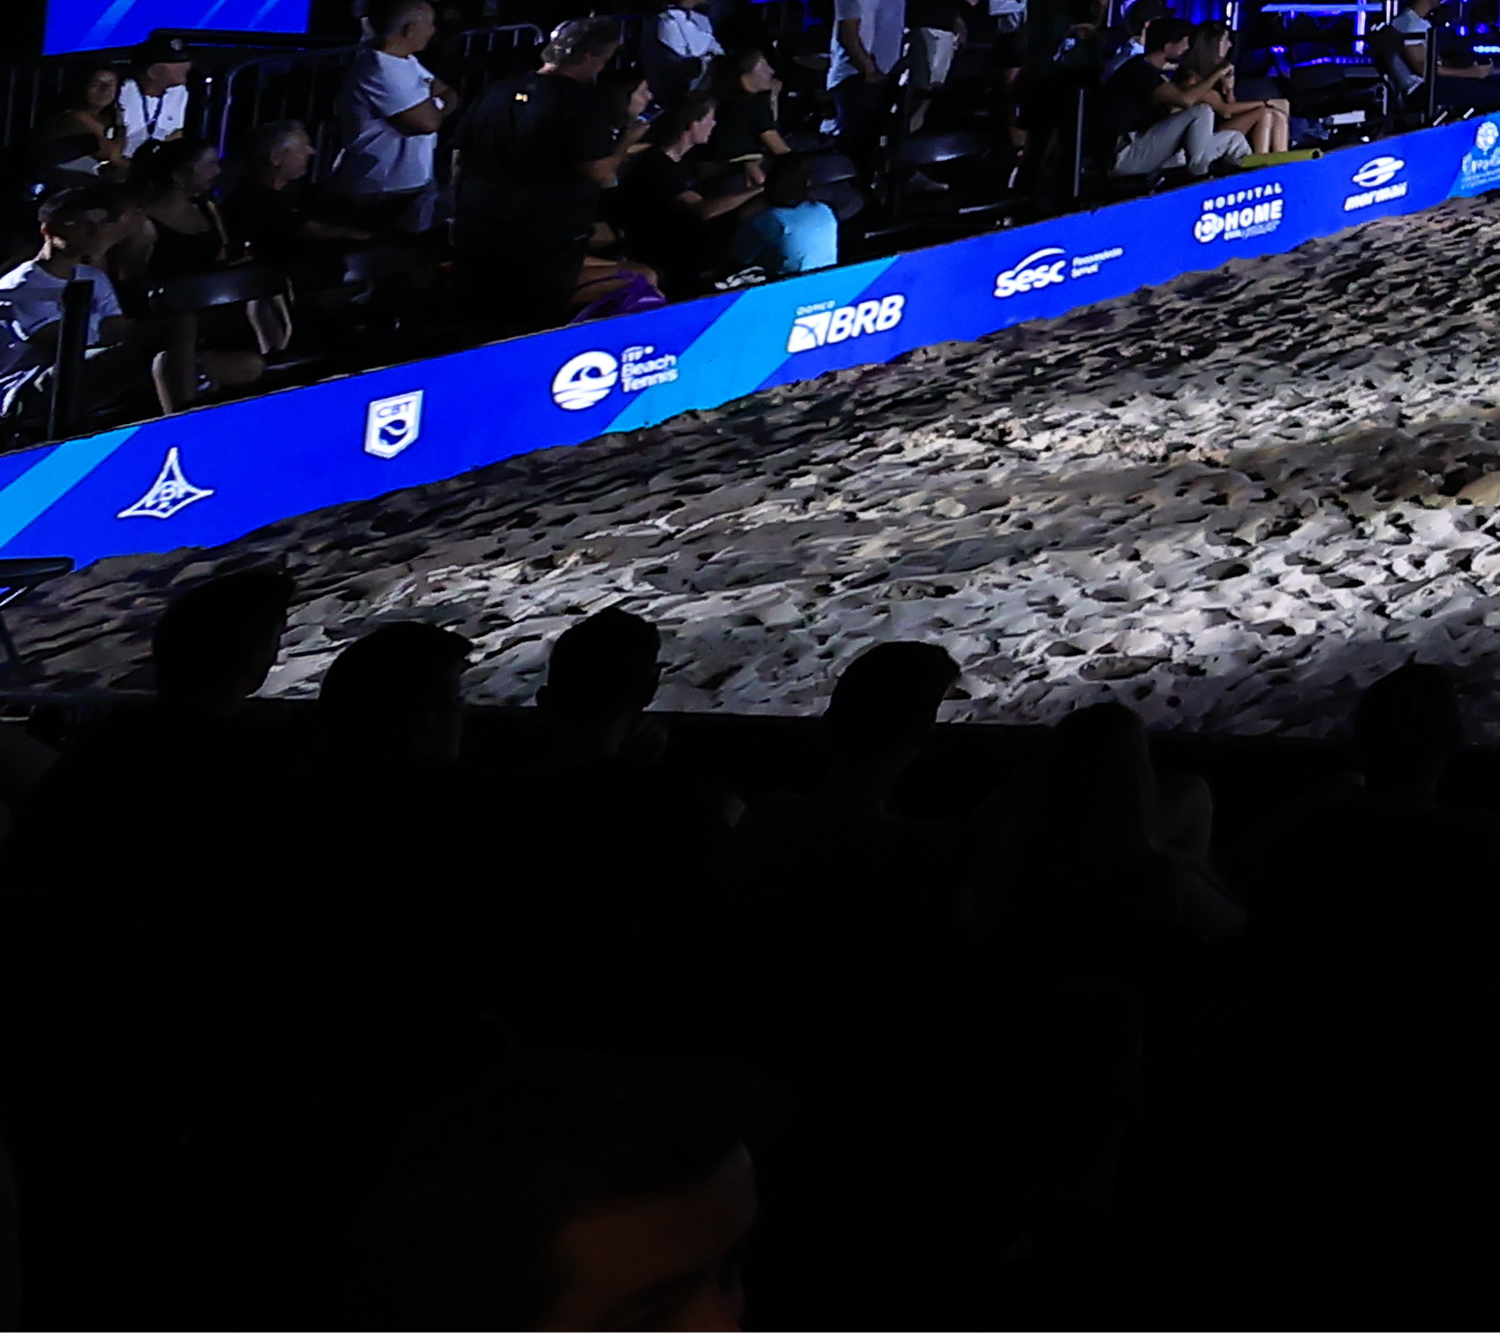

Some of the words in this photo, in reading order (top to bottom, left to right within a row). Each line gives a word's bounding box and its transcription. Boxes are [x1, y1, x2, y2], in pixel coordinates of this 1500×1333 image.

[1203, 182, 1283, 211] HOSPITAL
[1225, 199, 1283, 232] HOME
[826, 294, 906, 344] BRB
[621, 354, 677, 378] Beach
[621, 368, 679, 393] Tennis
[377, 400, 412, 418] CBT
